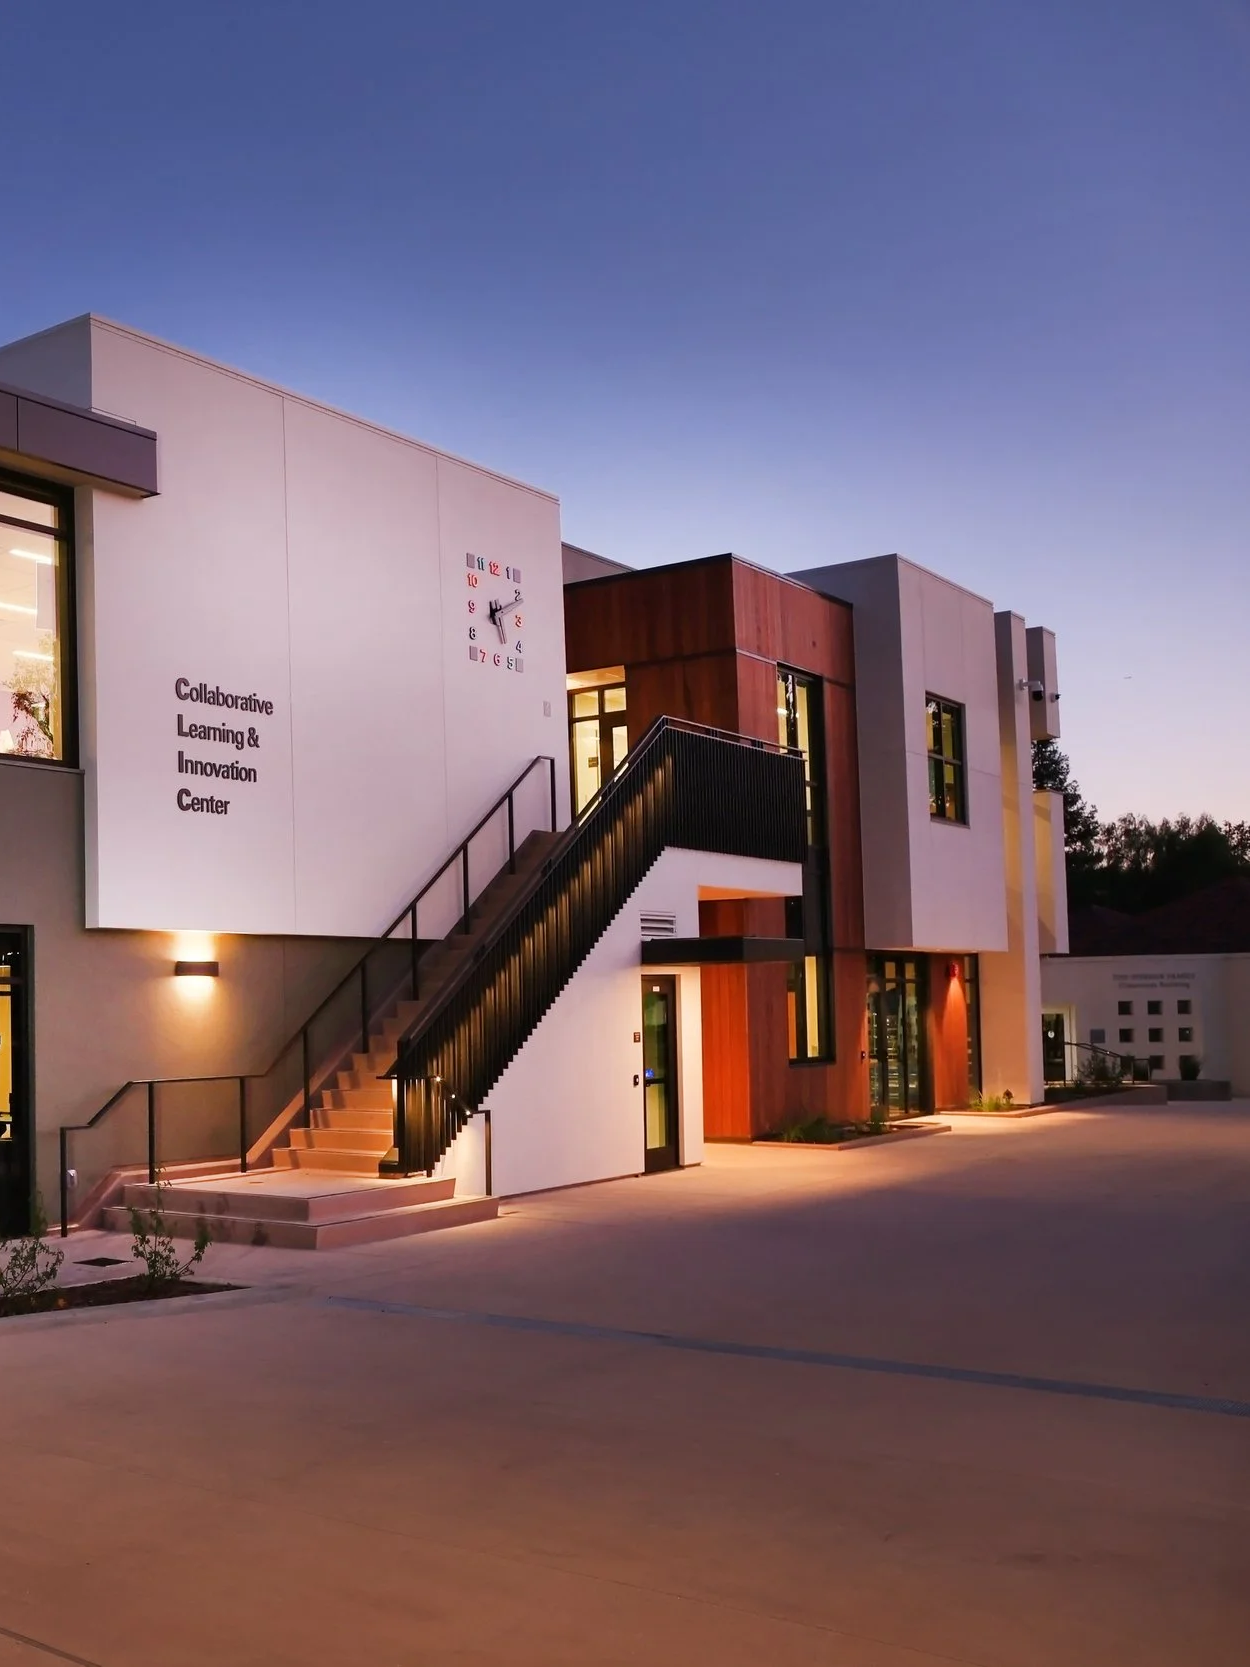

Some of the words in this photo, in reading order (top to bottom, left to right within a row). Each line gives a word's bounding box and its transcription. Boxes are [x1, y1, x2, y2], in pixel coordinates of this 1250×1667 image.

[477, 556, 485, 571] 11
[489, 561, 500, 577] 12
[467, 573, 478, 588] 10
[468, 600, 475, 614] 9
[515, 614, 522, 628] 3
[469, 626, 476, 640] 8
[515, 640, 522, 653] 4
[480, 648, 487, 663] 7
[493, 653, 501, 666] 6
[507, 656, 514, 670] 5
[175, 677, 274, 716] Collaborative
[177, 714, 245, 751] Learning
[247, 727, 260, 749] &
[177, 750, 257, 783] Innovation
[177, 788, 230, 816] Center
